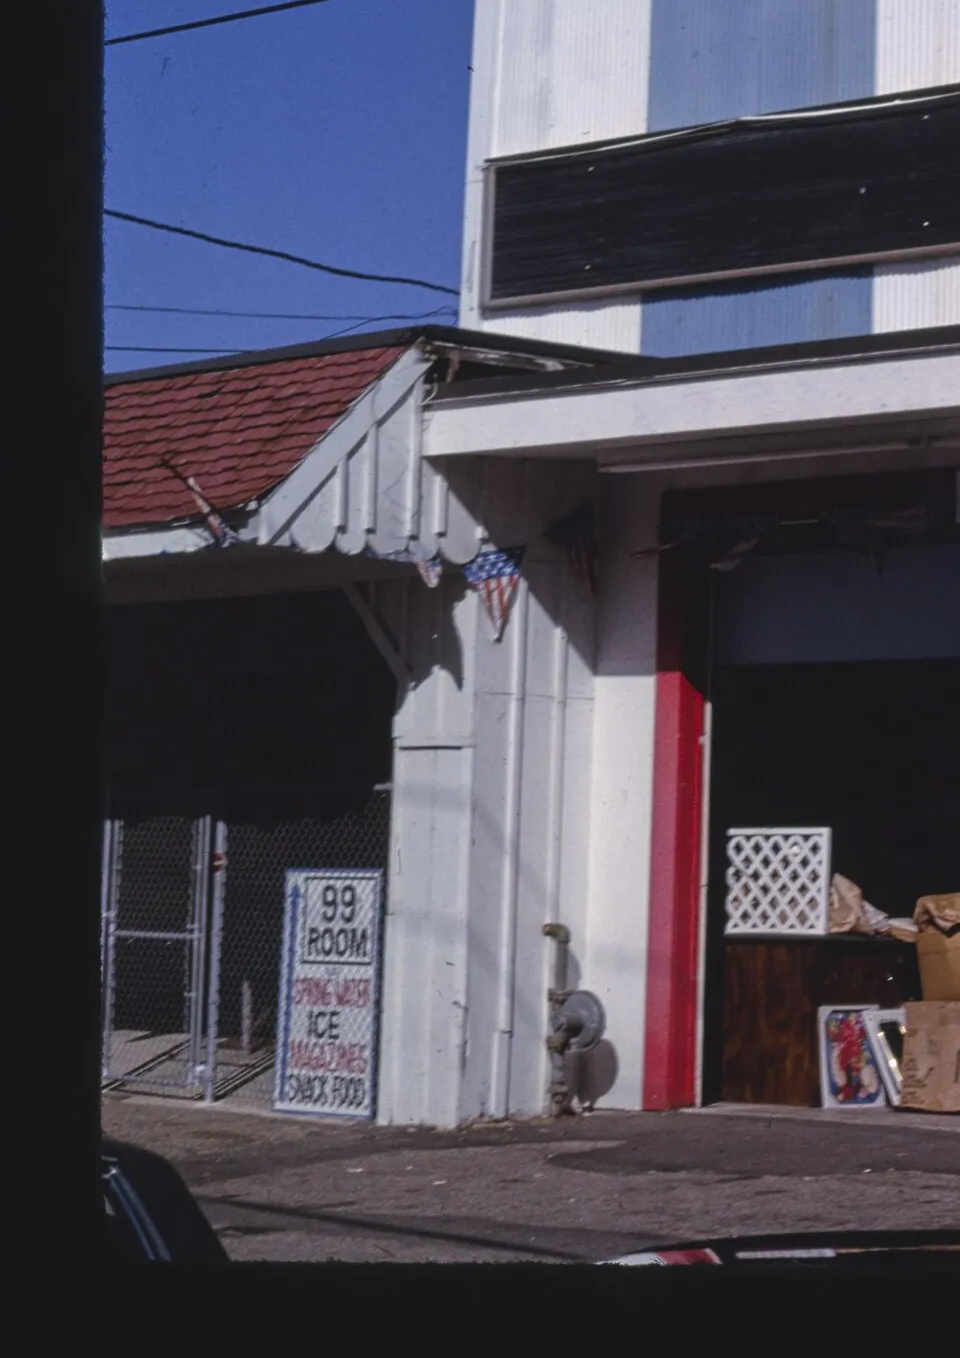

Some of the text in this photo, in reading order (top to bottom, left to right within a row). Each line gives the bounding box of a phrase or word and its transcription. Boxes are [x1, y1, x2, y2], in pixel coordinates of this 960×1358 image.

[322, 884, 356, 923] 99
[307, 926, 368, 957] ROOM
[308, 1009, 340, 1039] ICE
[287, 1073, 366, 1109] SNACK FOOD
